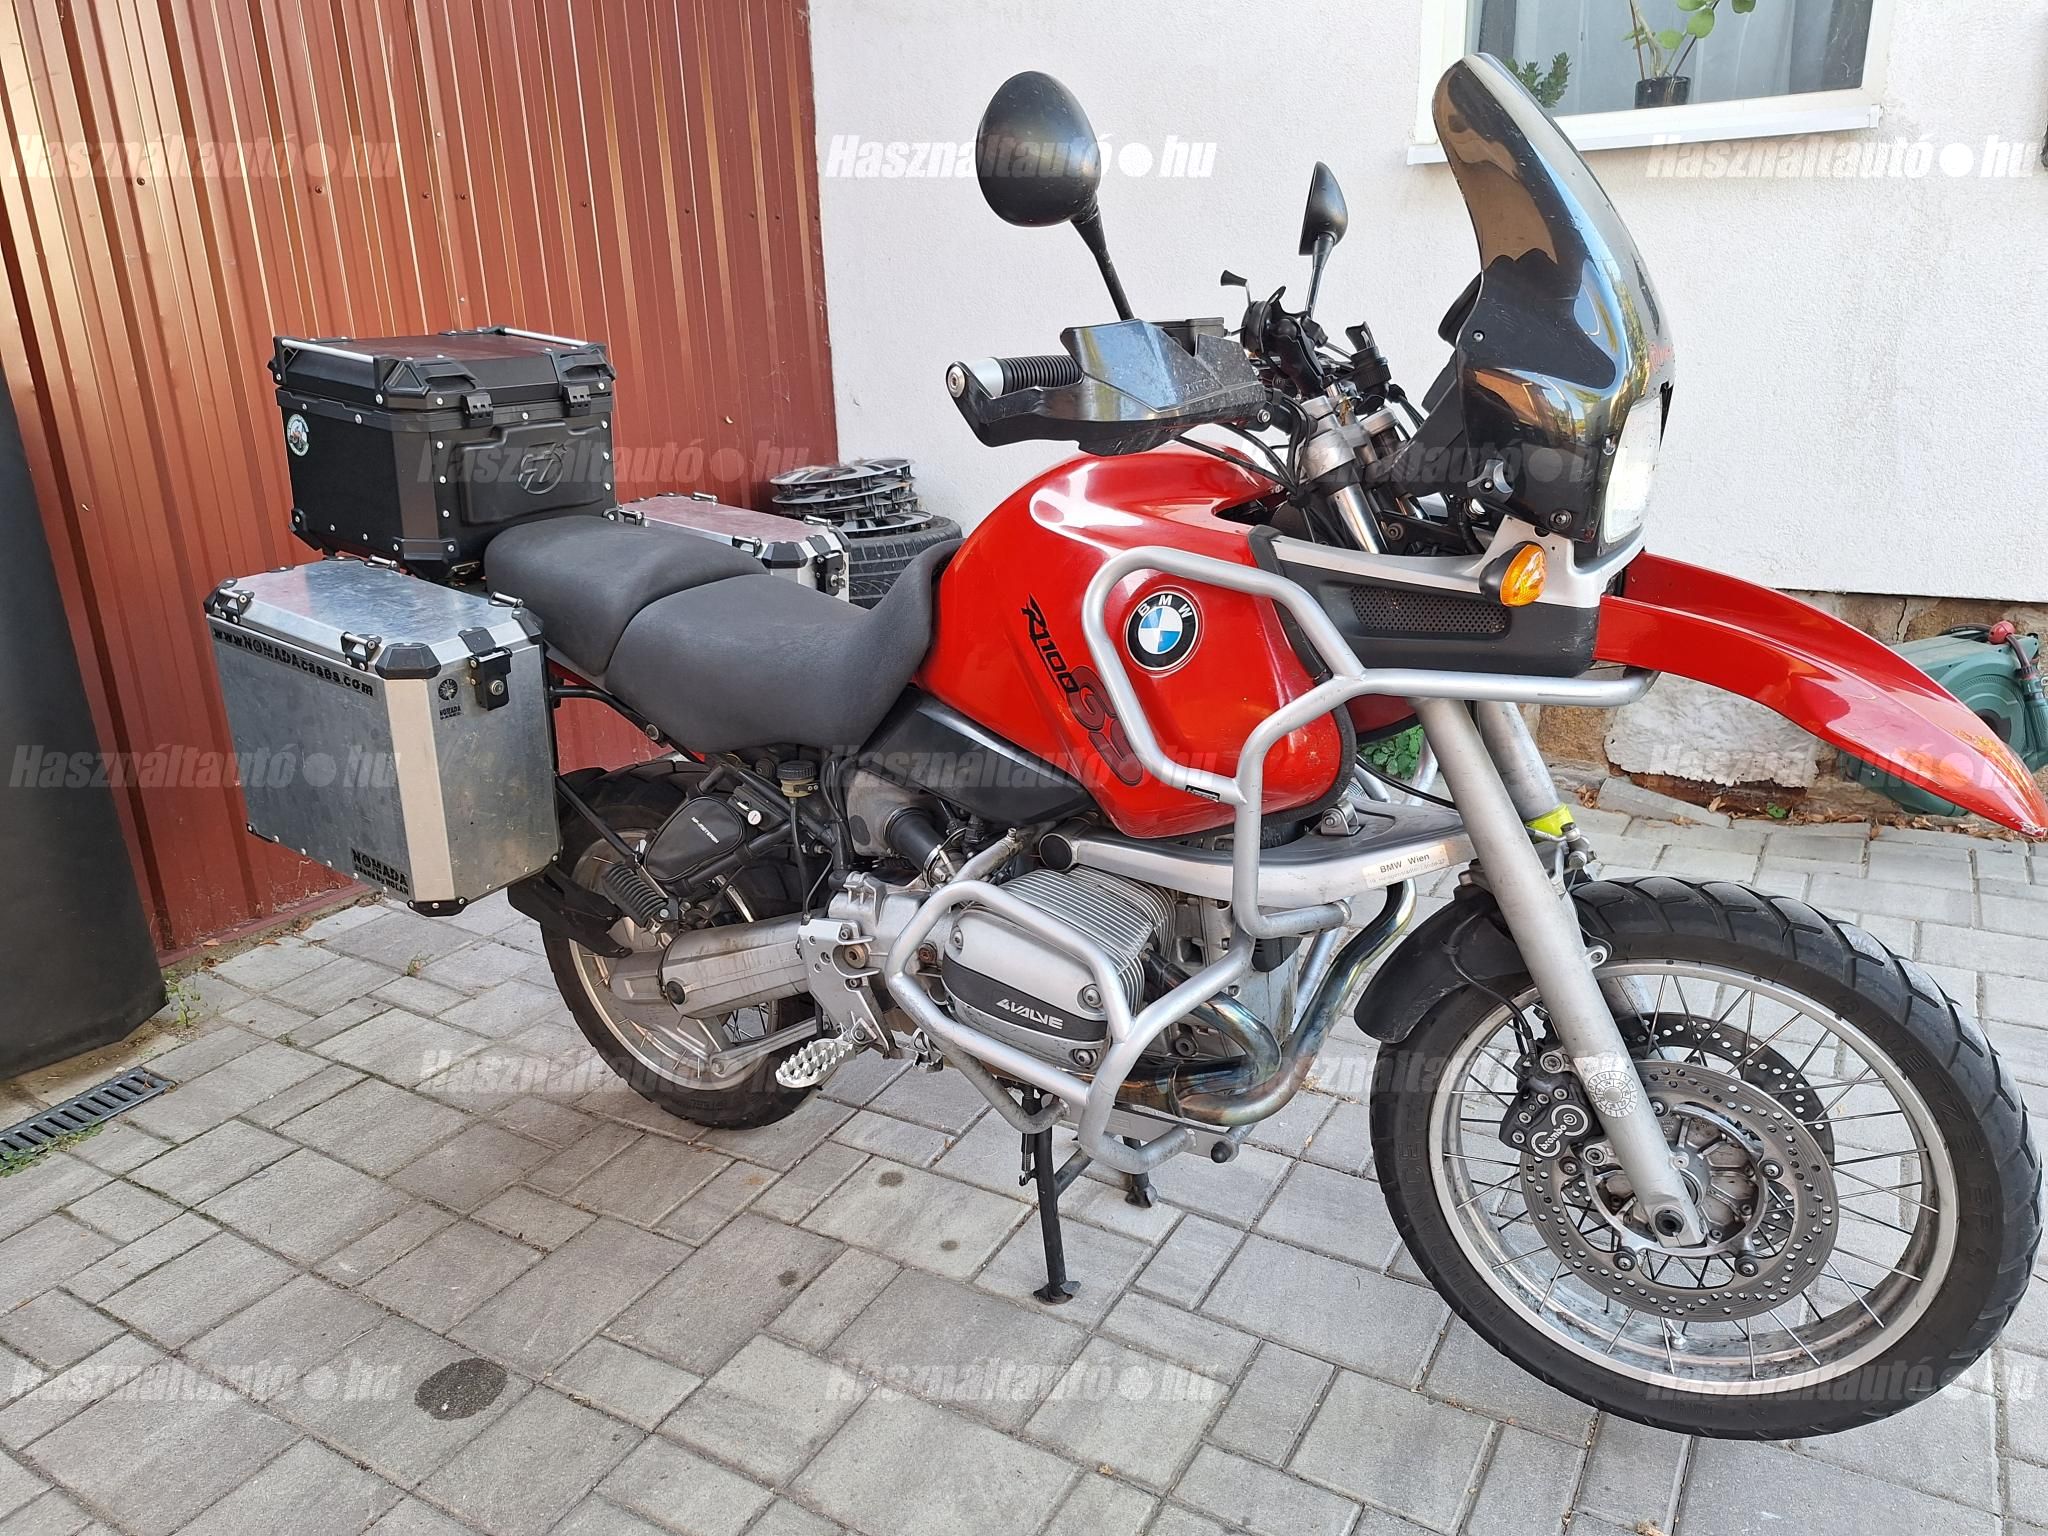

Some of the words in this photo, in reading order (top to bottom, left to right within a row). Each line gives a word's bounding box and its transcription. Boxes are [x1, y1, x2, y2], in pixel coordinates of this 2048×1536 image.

[1137, 594, 1193, 619] BMW
[351, 847, 409, 888] NOMADA
[1380, 861, 1403, 874] BMW
[1407, 853, 1430, 865] Wien
[1538, 1124, 1568, 1151] brembo
